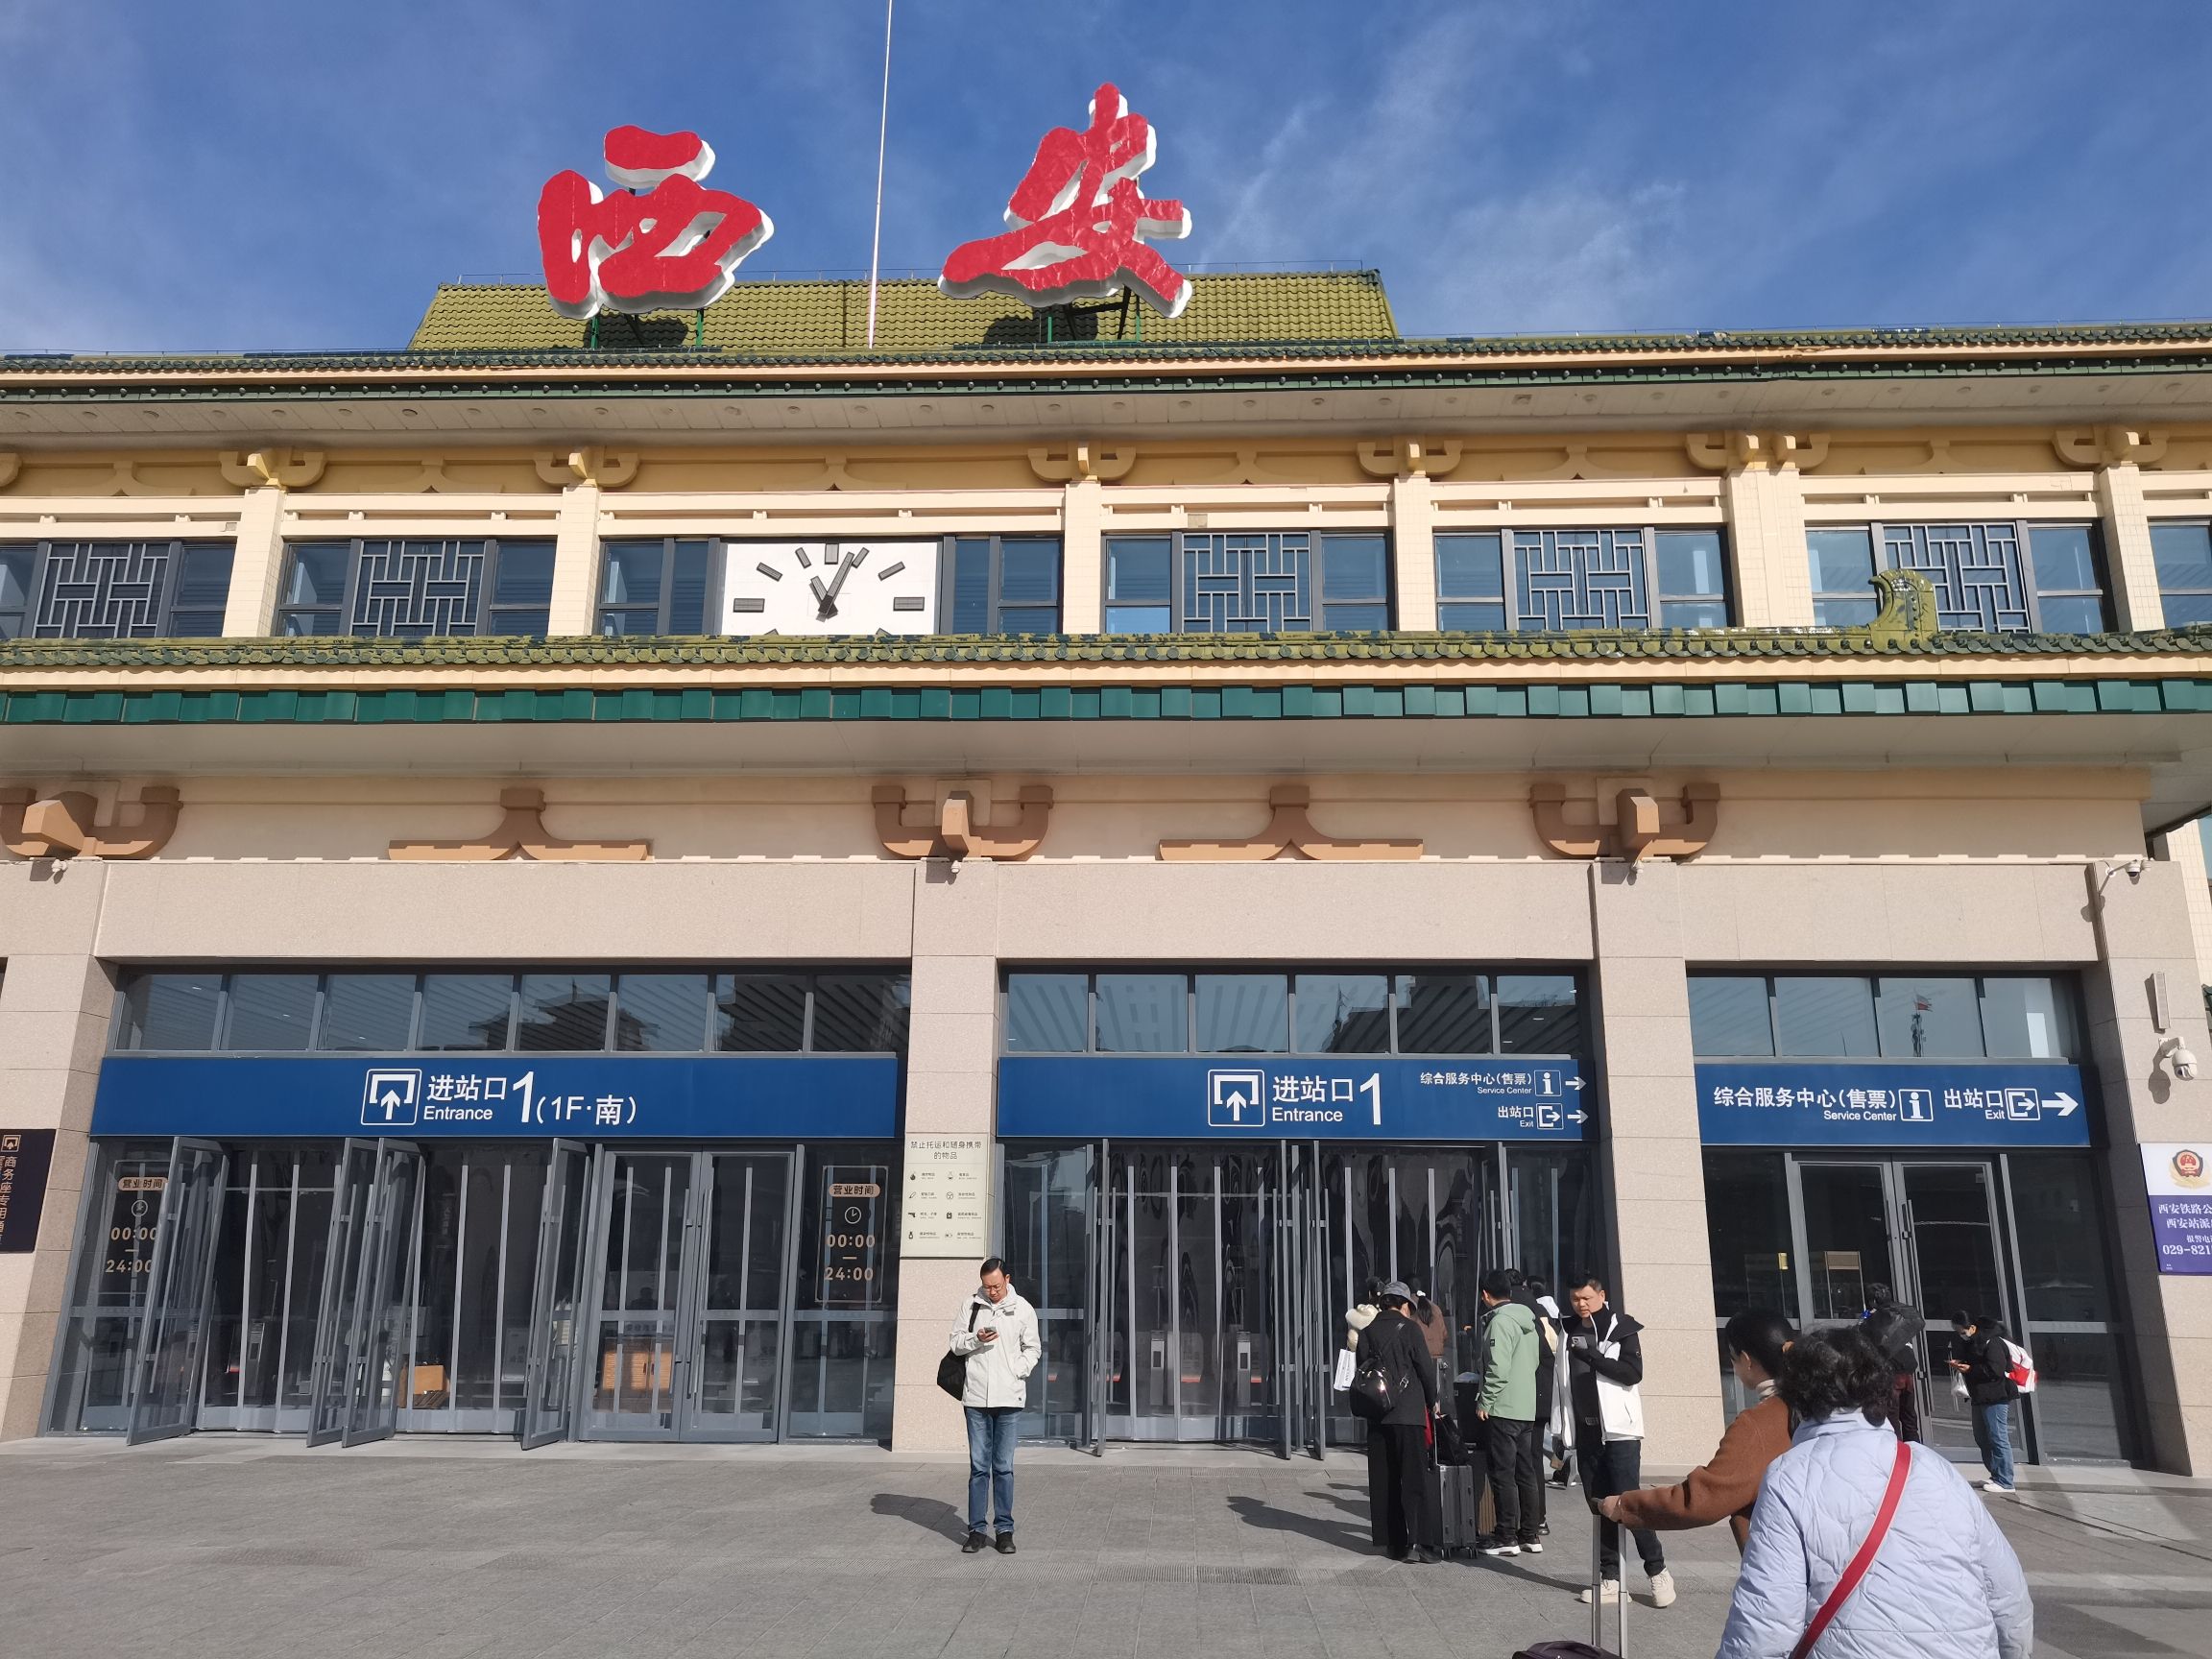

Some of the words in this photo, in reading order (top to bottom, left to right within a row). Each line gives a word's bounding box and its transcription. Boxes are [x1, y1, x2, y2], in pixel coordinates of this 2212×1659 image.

[538, 82, 1192, 319] 西安
[1420, 1071, 1533, 1086] 综合服务中心(售票)
[426, 1073, 508, 1102] 进站口
[1272, 1074, 1355, 1103] 进站口
[1477, 1086, 1505, 1094] Service
[1506, 1086, 1532, 1094] Center
[1713, 1086, 1896, 1110] 综合服务中心(售票)
[1943, 1088, 2004, 1109] 出站口
[422, 1105, 493, 1120] Entrance
[1271, 1106, 1344, 1122] Entrance
[1498, 1105, 1534, 1118] 出站口
[1823, 1109, 1862, 1120] Service
[1863, 1110, 1897, 1121] Center
[1984, 1109, 2006, 1120] Exit
[1519, 1119, 1534, 1128] Exit
[910, 1141, 982, 1149] 禁止托运和随身携带
[933, 1151, 958, 1160] 的物品
[122, 1179, 163, 1189] 营业时间
[832, 1185, 875, 1195] 营业时间
[2166, 1217, 2212, 1229] 西安站派
[827, 1234, 876, 1248] 00:00
[2186, 1235, 2212, 1243] 报警电
[2162, 1244, 2212, 1255] 029-821
[824, 1266, 874, 1282] 24:00
